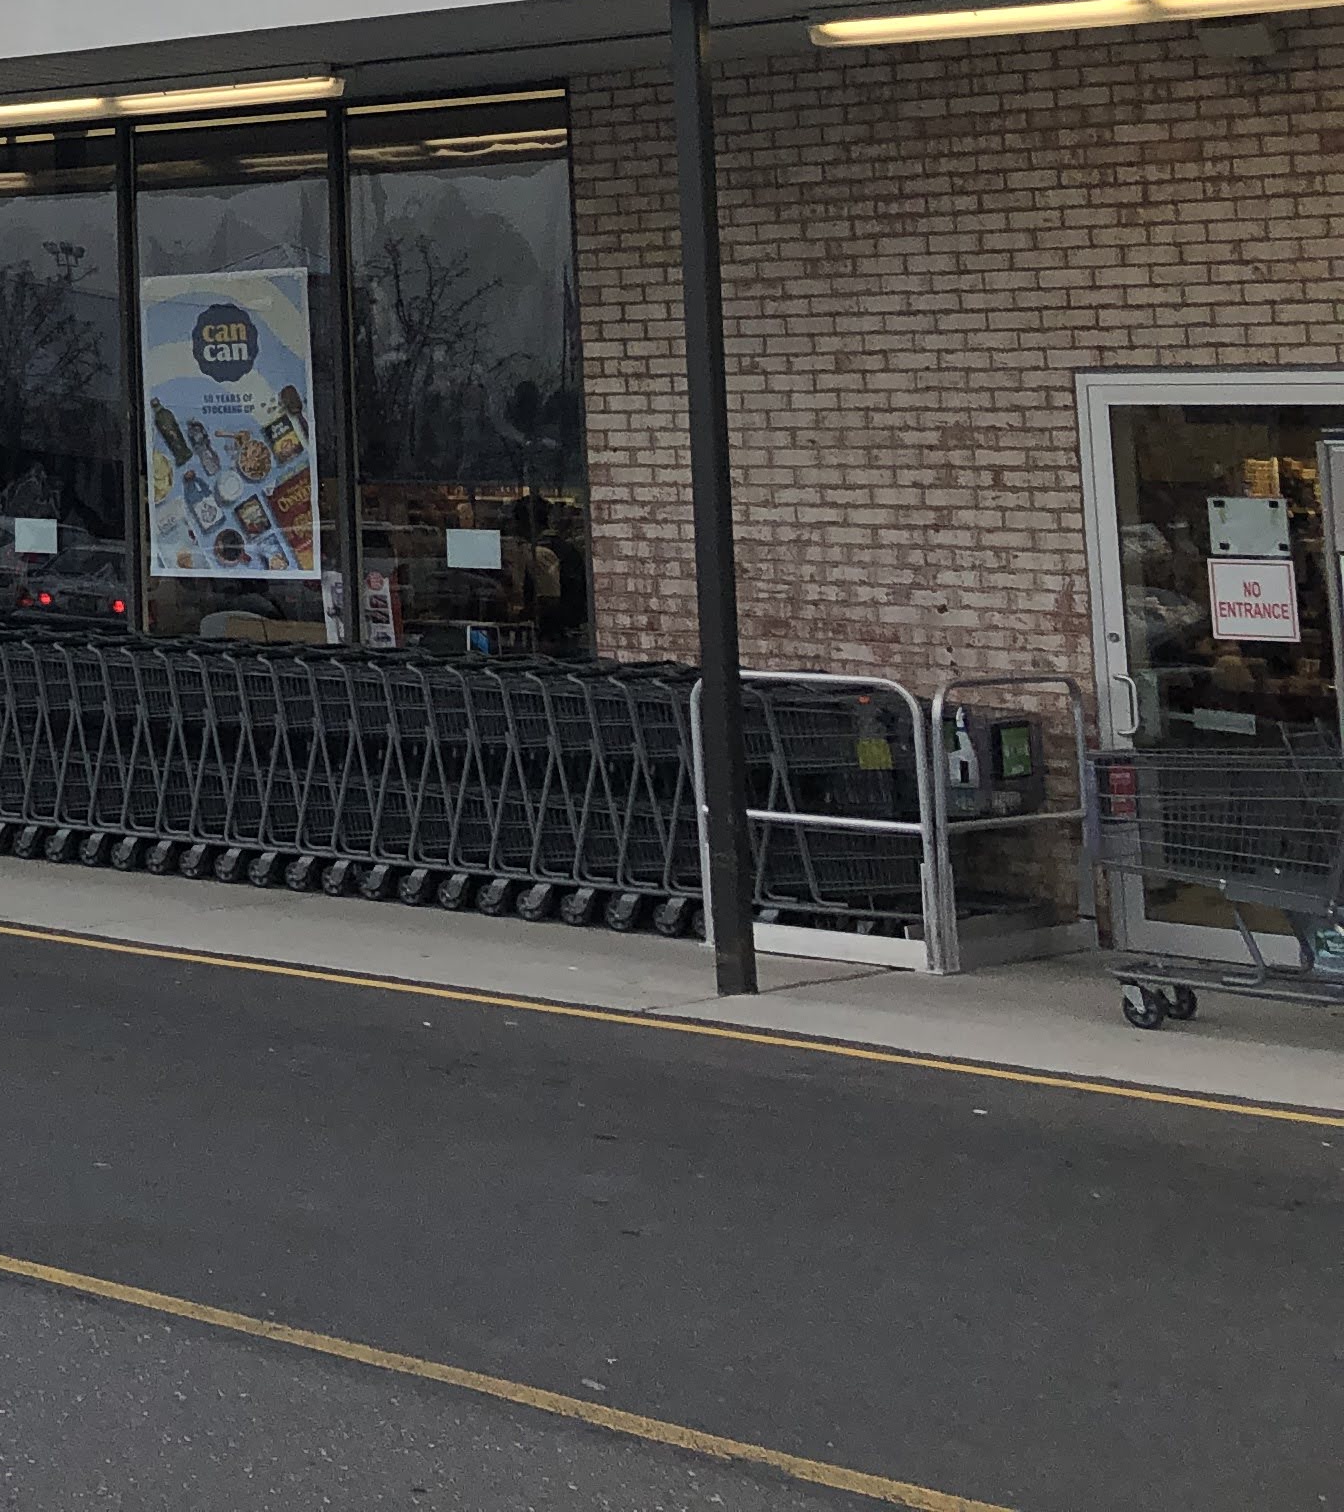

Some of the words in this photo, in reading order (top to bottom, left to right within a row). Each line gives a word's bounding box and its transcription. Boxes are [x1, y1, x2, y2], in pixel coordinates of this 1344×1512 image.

[202, 322, 248, 342] can
[203, 343, 249, 362] can
[215, 394, 241, 403] YEARS
[242, 393, 253, 403] OF
[1243, 581, 1262, 598] NO
[1218, 602, 1290, 620] ENTRANCE
